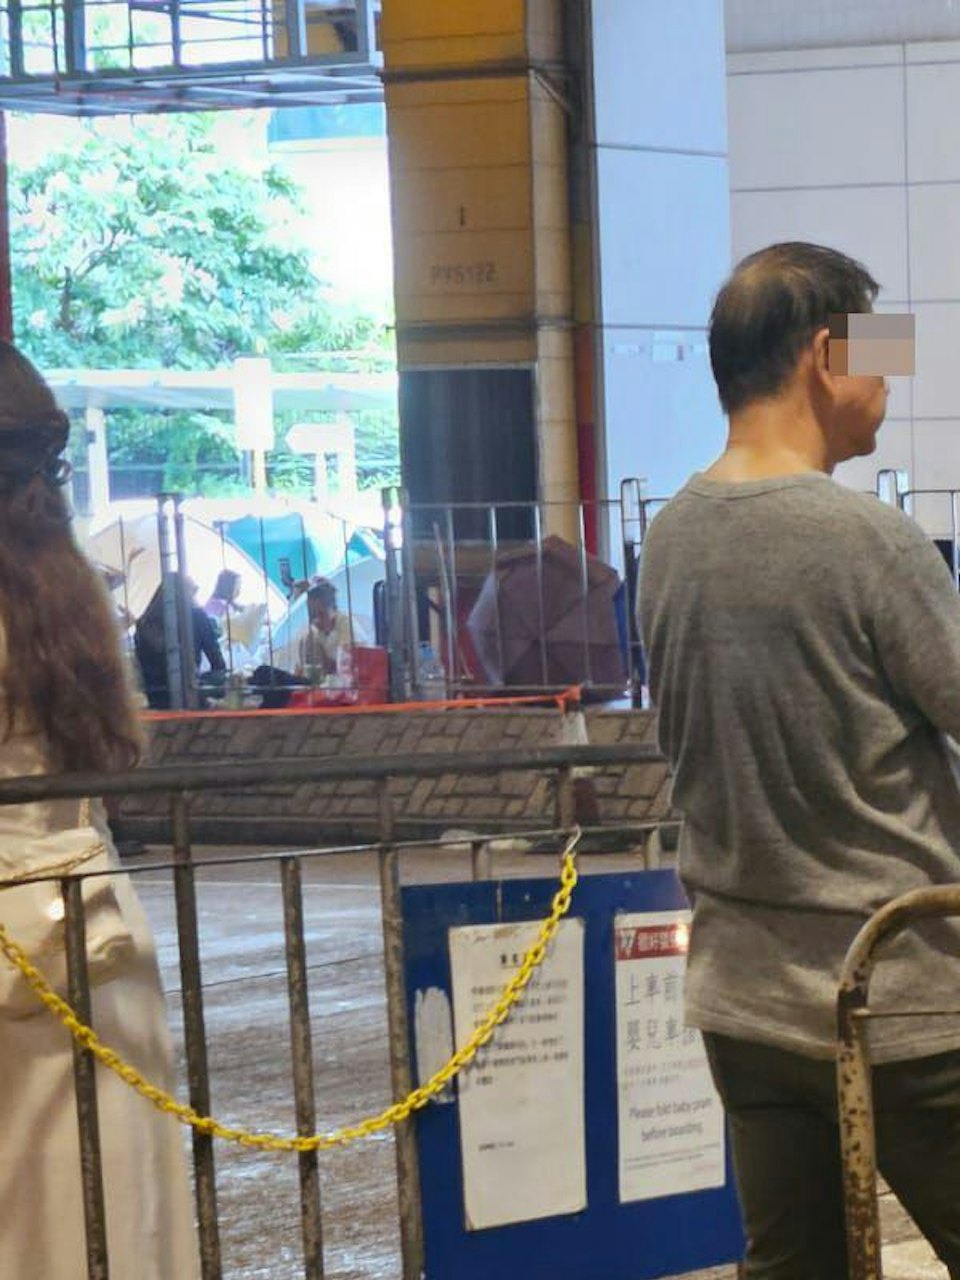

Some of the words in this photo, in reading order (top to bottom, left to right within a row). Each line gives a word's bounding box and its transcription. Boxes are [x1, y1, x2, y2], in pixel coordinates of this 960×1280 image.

[628, 1104, 654, 1121] Please
[656, 1101, 671, 1116] fold
[673, 1099, 692, 1116] baby
[692, 1097, 713, 1115] pram
[641, 1125, 666, 1143] before
[667, 1121, 704, 1139] boarding
